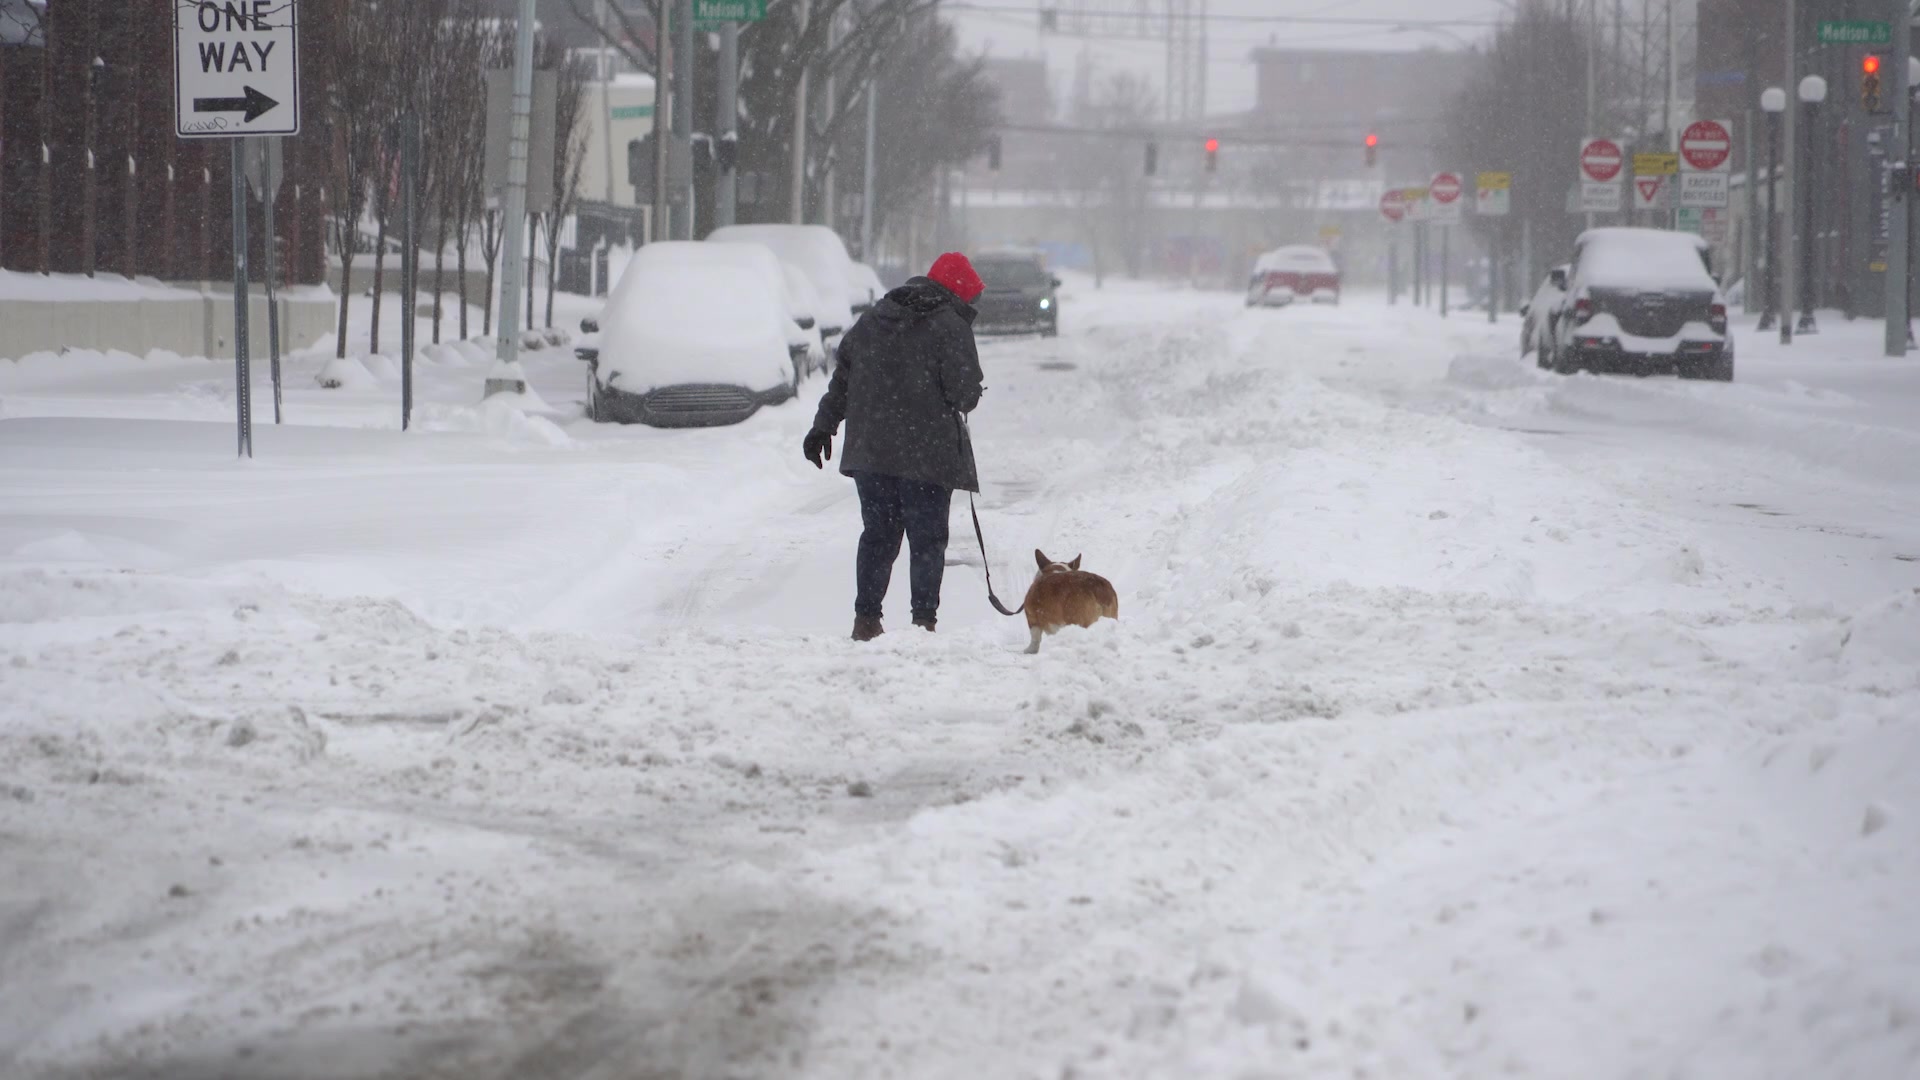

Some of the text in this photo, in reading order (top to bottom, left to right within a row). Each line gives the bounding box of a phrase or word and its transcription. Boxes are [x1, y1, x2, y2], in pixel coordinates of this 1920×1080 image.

[198, 0, 273, 32] ONE
[699, 1, 745, 17] Madison
[1824, 24, 1869, 40] Madison
[198, 41, 276, 73] WAY
